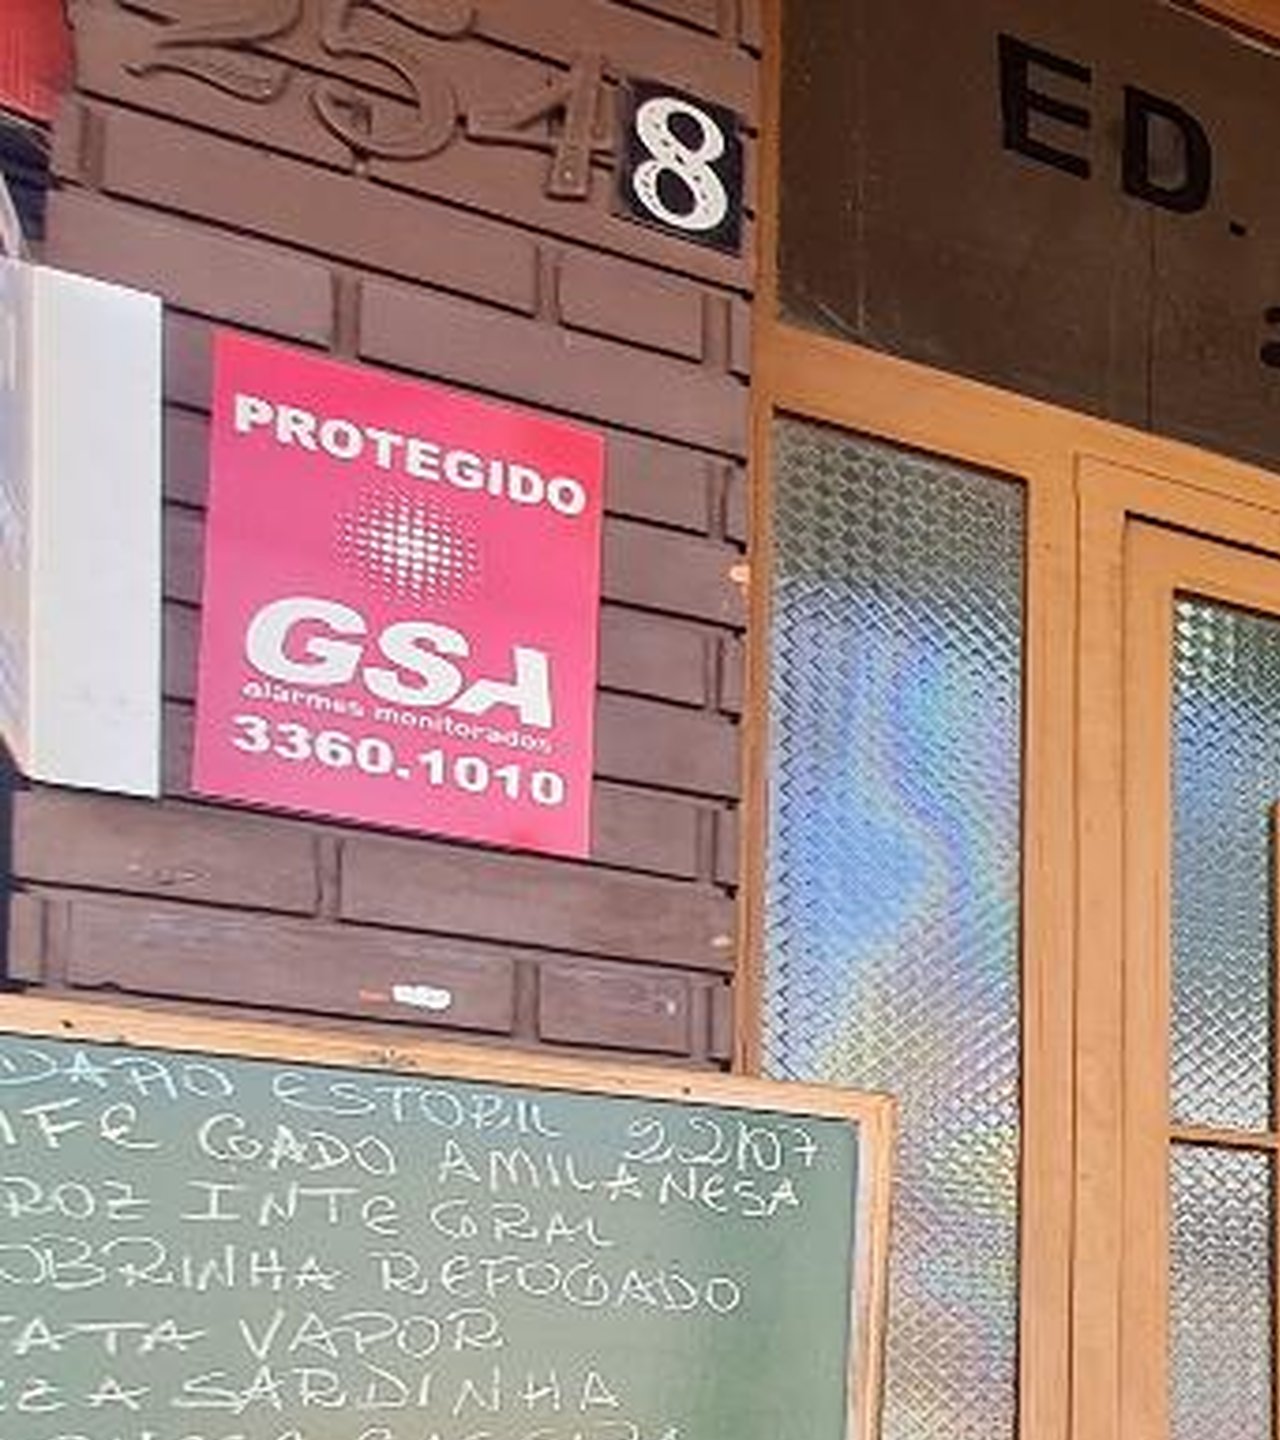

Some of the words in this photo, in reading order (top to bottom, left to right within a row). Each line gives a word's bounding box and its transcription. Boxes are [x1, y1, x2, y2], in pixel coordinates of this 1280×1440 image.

[999, 34, 1247, 238] ED.
[234, 392, 588, 517] PROTEGIDO
[246, 596, 553, 728] GSA
[232, 714, 566, 804] 3360.1010
[242, 681, 365, 719] alarmes
[373, 706, 554, 755] monitorados
[239, 1308, 504, 1359] VAPOR
